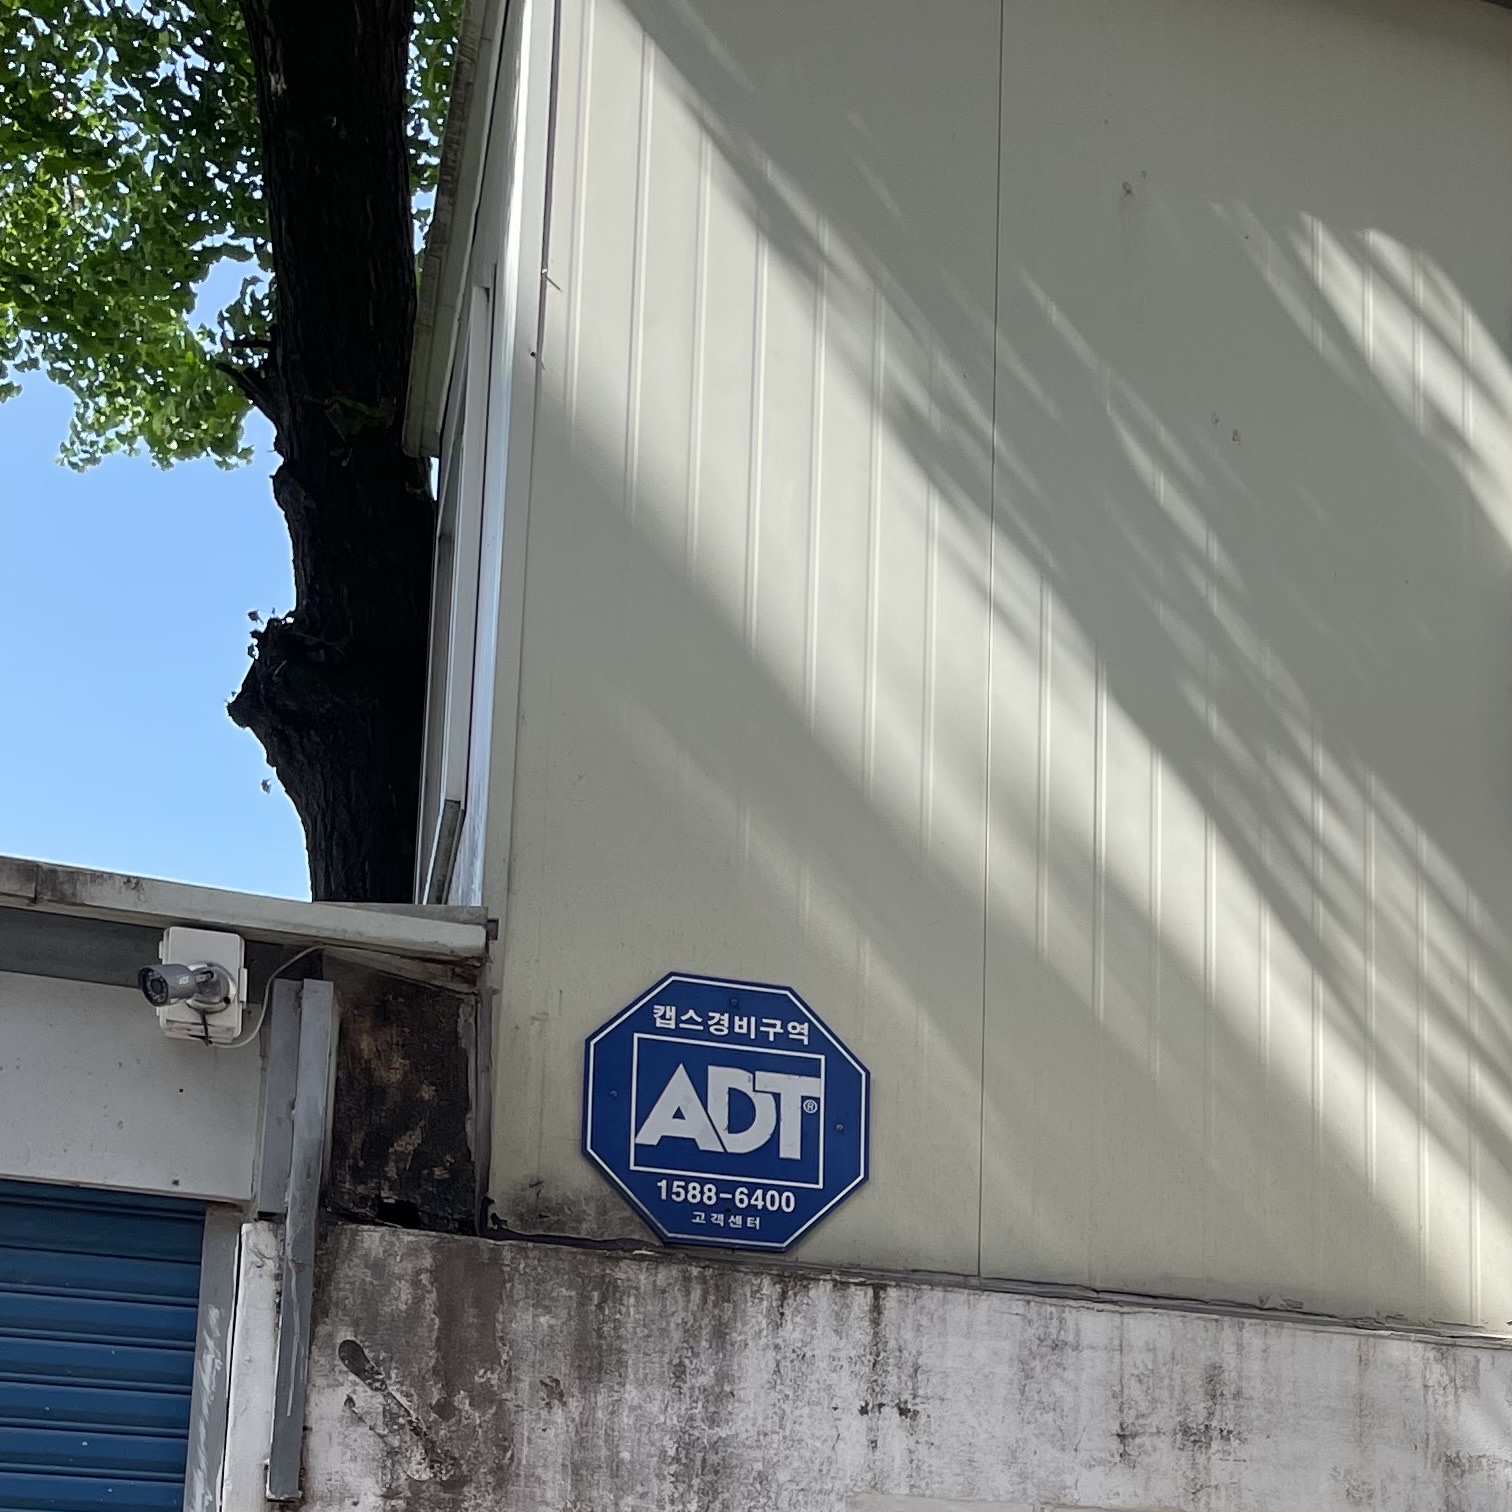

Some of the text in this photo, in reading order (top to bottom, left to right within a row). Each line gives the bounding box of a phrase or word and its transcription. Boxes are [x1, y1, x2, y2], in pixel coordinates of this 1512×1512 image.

[653, 1004, 810, 1045] 캡스경비구역
[634, 1062, 822, 1161] ADT
[657, 1179, 796, 1213] 1588-6400
[692, 1211, 761, 1231] 고객센터
